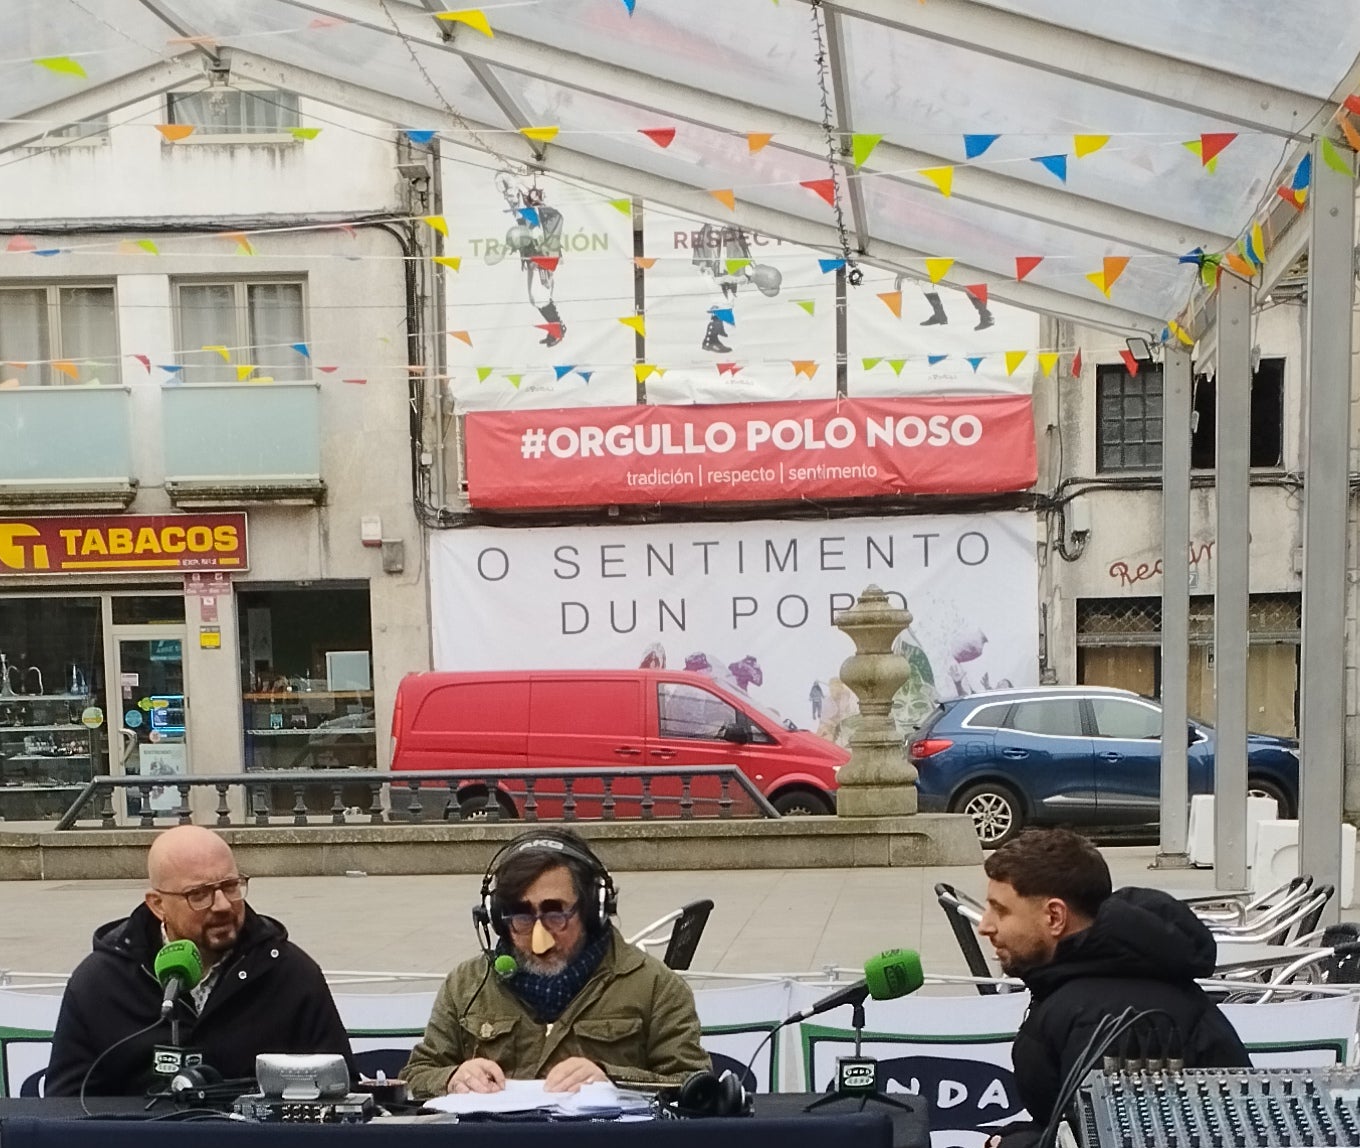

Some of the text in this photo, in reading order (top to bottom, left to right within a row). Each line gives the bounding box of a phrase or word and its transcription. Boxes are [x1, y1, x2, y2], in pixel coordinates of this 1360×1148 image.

[520, 414, 983, 460] #ORGULLO POLO NOSO
[625, 462, 878, 486] tradición respecto sentimento
[59, 525, 240, 556] TABACOS
[477, 531, 991, 582] O SENTIMENTO
[562, 597, 688, 636] DUN
[886, 1077, 1010, 1110] NDA
